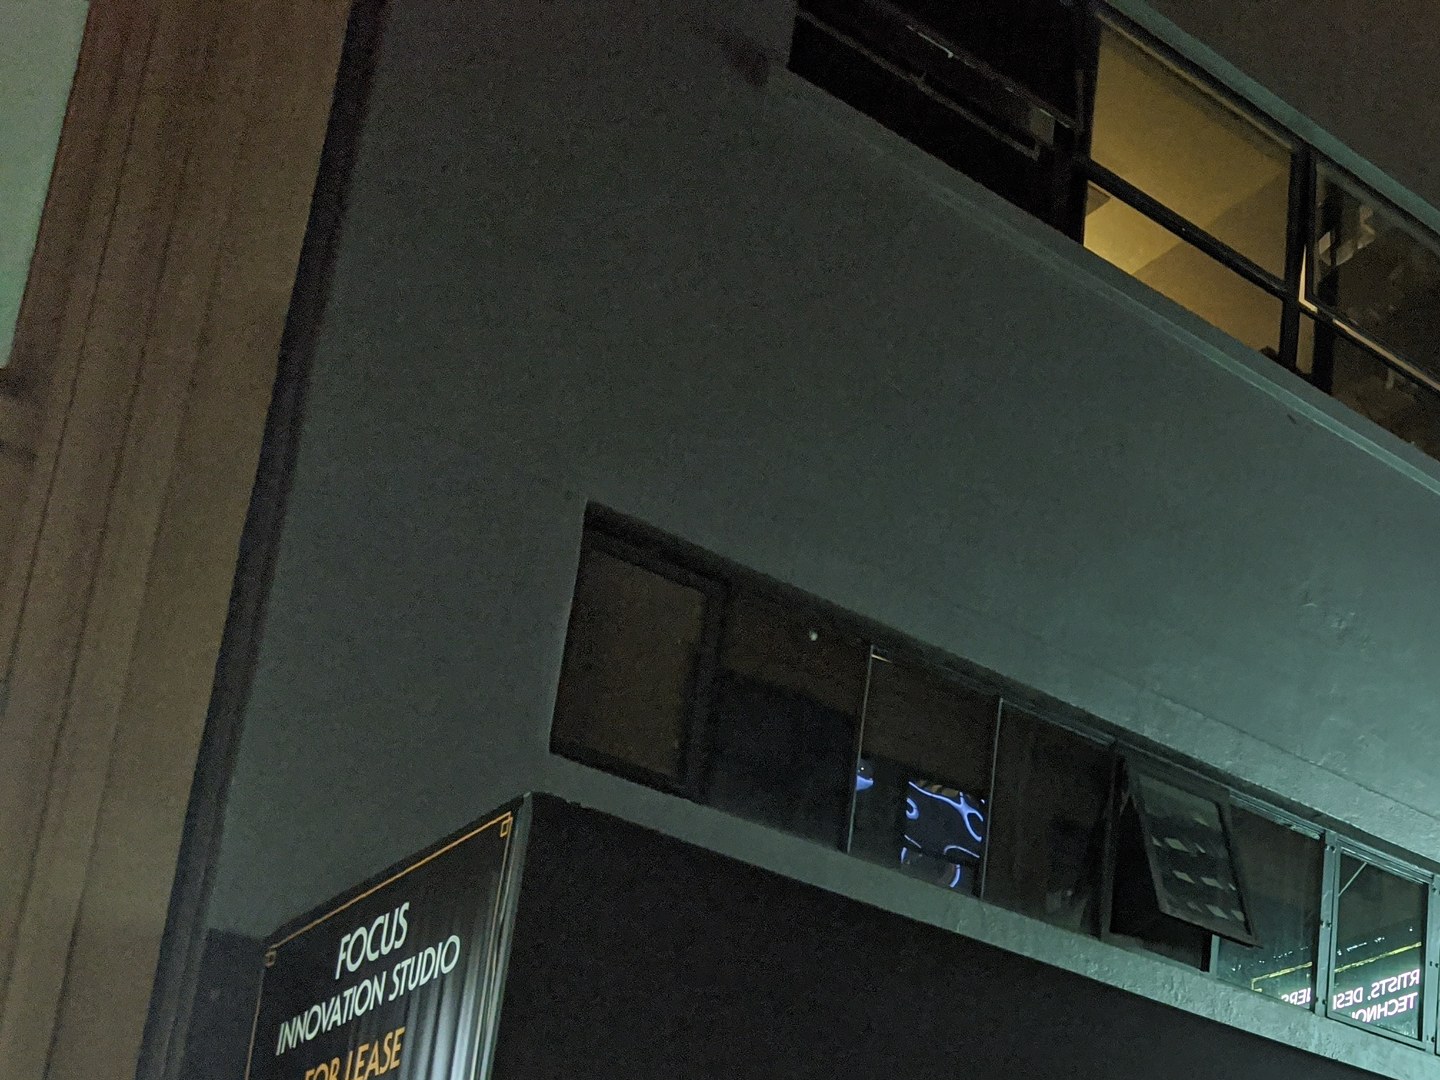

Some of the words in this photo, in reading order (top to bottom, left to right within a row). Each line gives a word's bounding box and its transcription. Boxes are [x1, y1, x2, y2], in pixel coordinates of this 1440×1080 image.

[335, 901, 410, 980] FOCUS
[276, 971, 386, 1056] INNOVATION
[388, 934, 461, 1002] STUDIO
